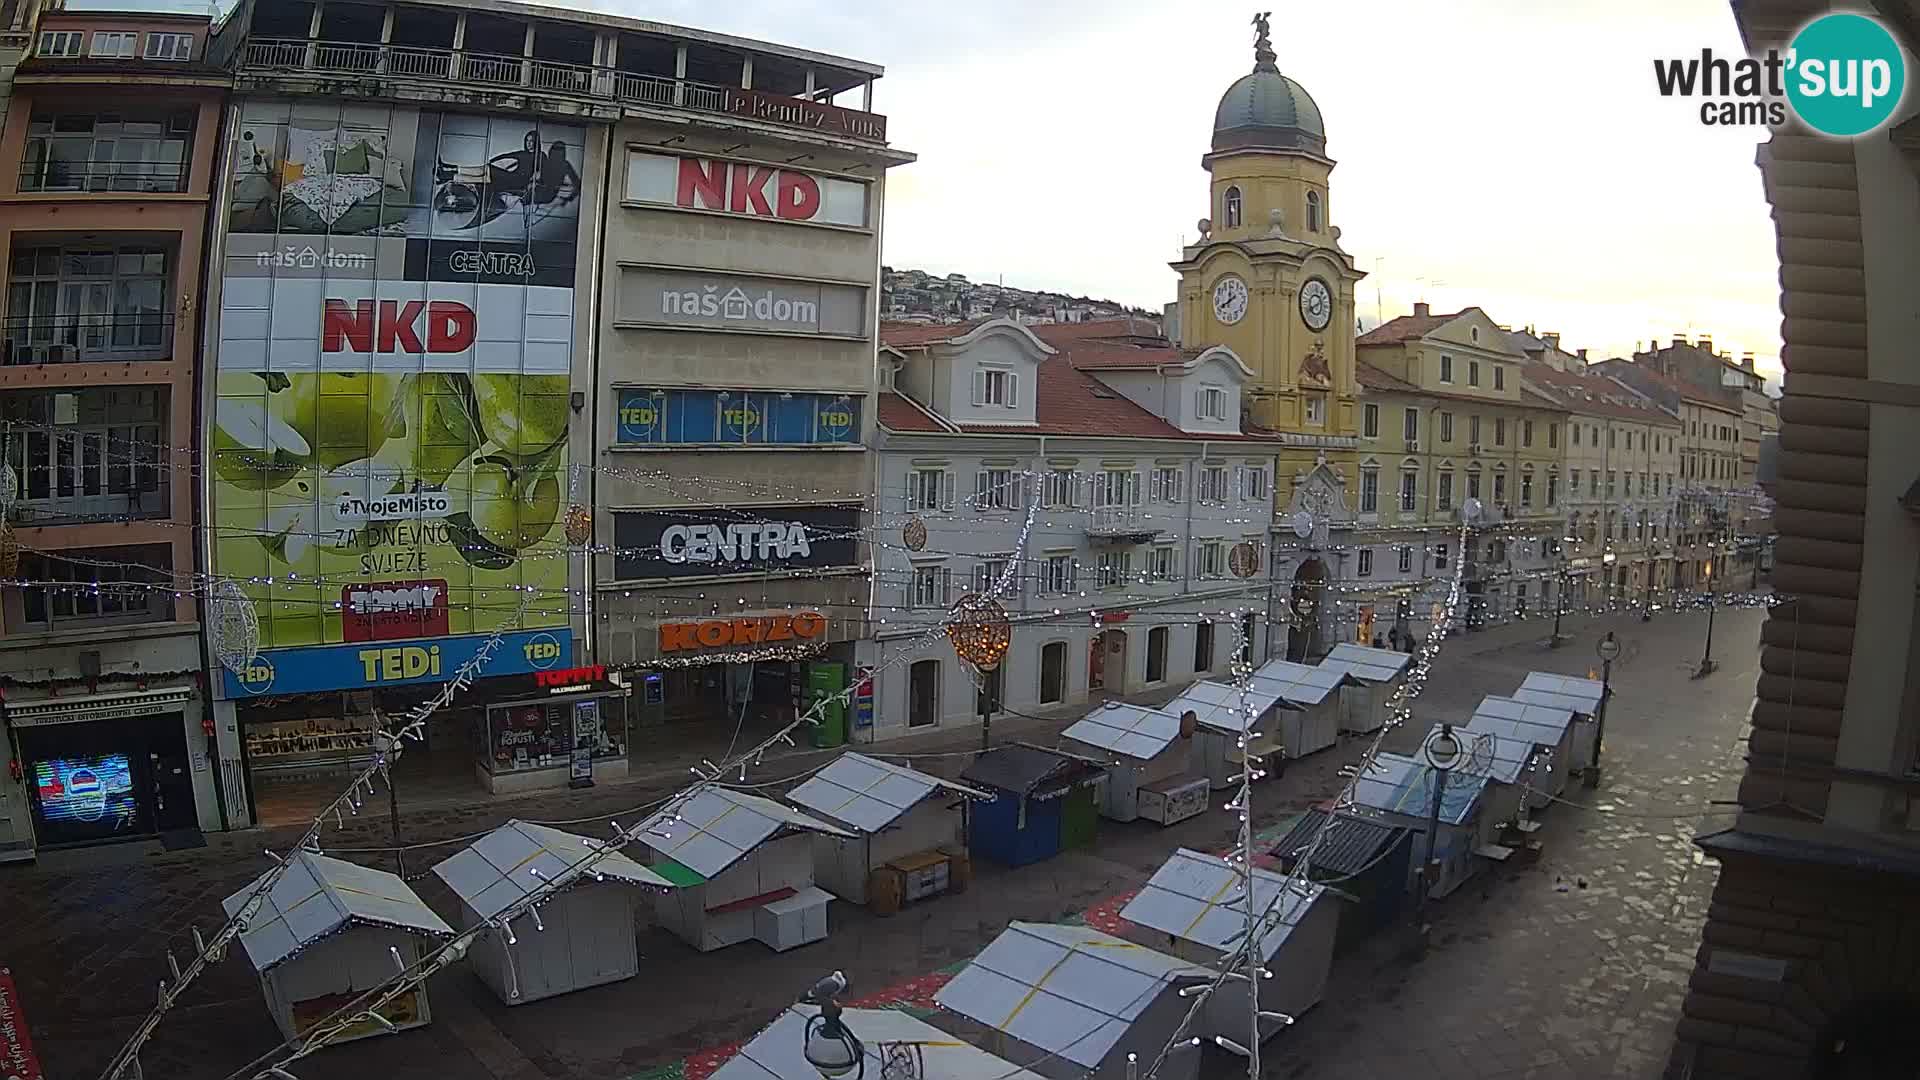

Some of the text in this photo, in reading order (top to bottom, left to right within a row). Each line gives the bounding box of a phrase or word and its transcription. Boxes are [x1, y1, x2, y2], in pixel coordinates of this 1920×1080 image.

[724, 89, 746, 113] Le
[676, 158, 821, 220] NKD
[256, 246, 367, 269] naš dom
[449, 250, 536, 276] CENTRA
[662, 285, 817, 322] naš dom
[322, 297, 478, 354] NKD
[620, 408, 658, 425] TEDi
[724, 409, 760, 425] TEDi
[820, 411, 853, 426] TEDi
[340, 497, 448, 517] #TvojeMisto
[335, 524, 451, 549] ZA DNEVNO
[660, 521, 811, 563] CENTRA
[360, 547, 428, 575] SVJEŽE
[350, 586, 441, 614] TOMMY
[660, 611, 827, 652] KORZO
[359, 645, 441, 681] TEDi
[523, 643, 561, 660] TEDi
[535, 664, 608, 688] TOMMY
